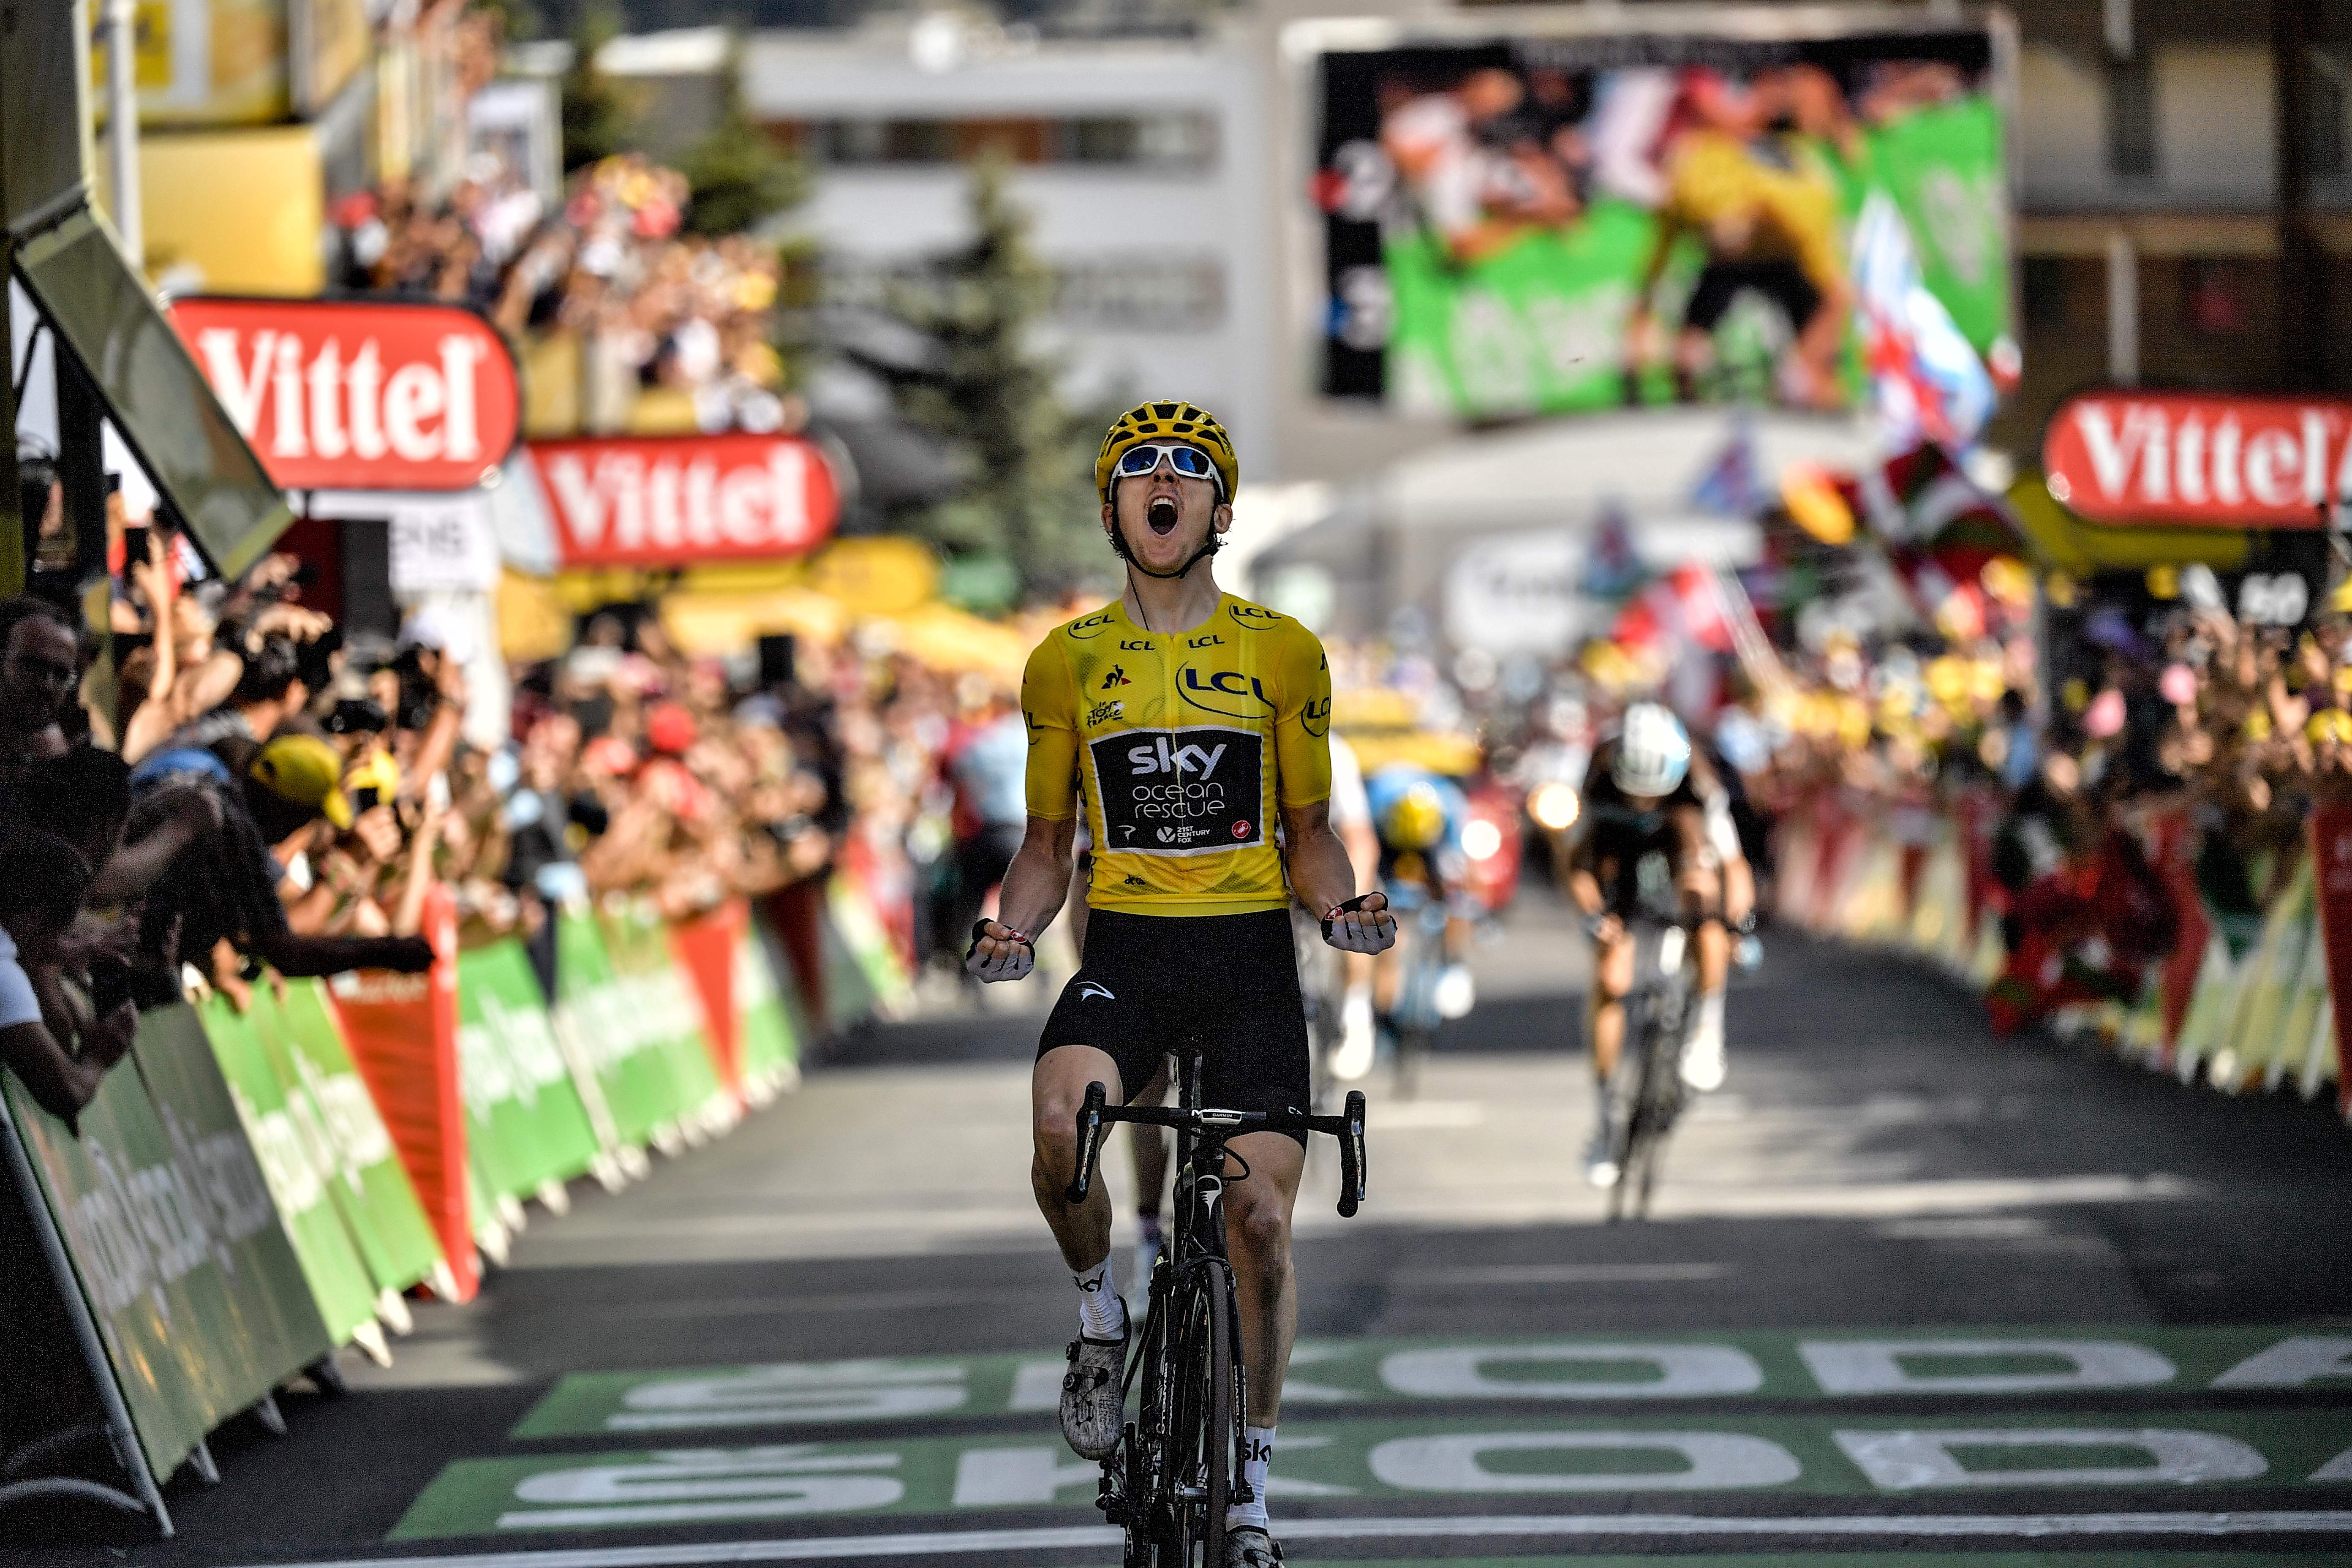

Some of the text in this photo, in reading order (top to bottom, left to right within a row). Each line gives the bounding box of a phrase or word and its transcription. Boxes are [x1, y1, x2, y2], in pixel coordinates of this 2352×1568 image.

[199, 327, 479, 462] Vittel
[2073, 400, 2330, 506] Vittel
[550, 441, 808, 551] Vittel
[1073, 613, 1115, 630] LCL
[1232, 605, 1282, 619] LCL
[1120, 640, 1156, 651] LCL
[1188, 634, 1225, 649] LCL
[1185, 668, 1275, 709] LCL
[1307, 696, 1330, 719] LC
[1128, 736, 1227, 780] sky
[1132, 782, 1224, 801] ocean
[1135, 800, 1225, 819] rescue
[1177, 829, 1211, 838] CENTURY
[1074, 1269, 1105, 1293] ky
